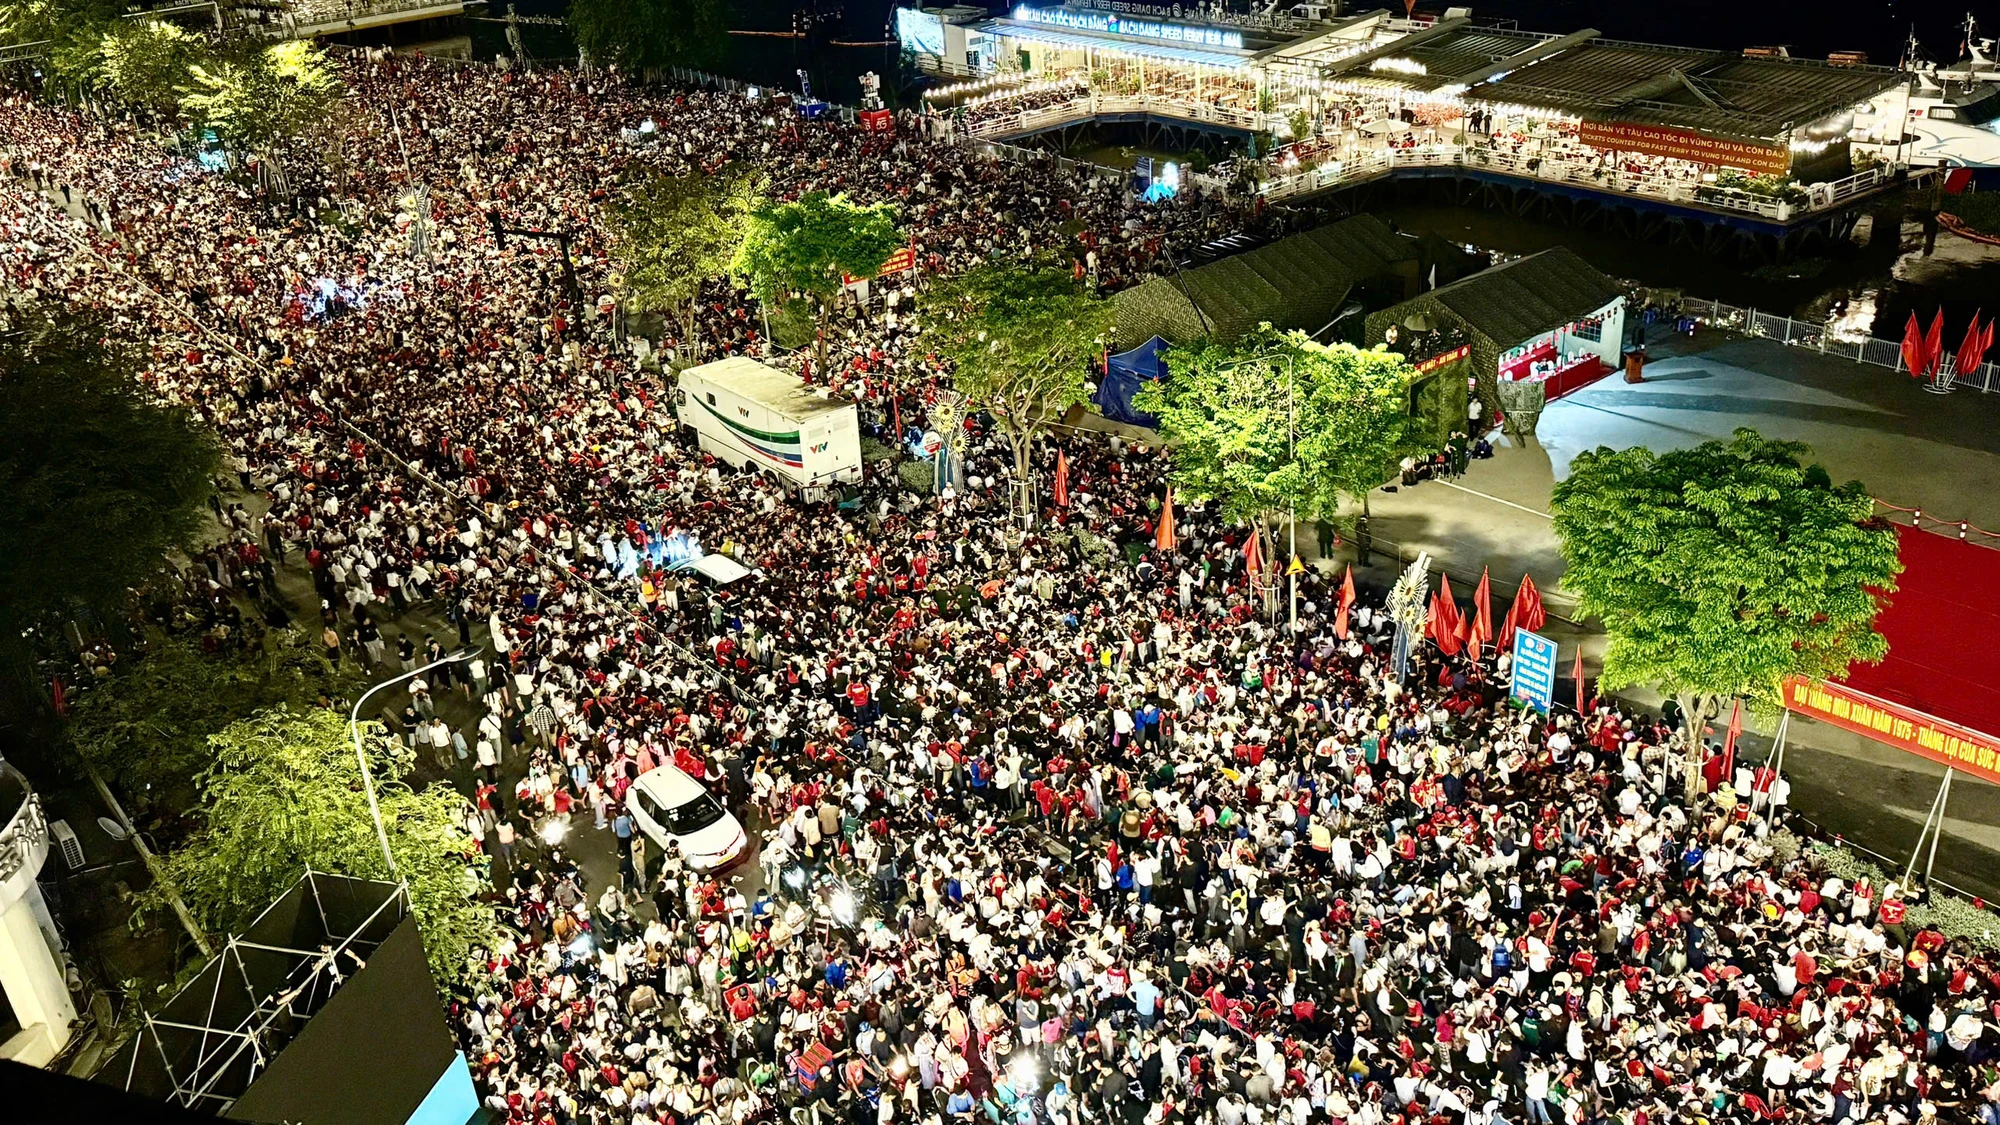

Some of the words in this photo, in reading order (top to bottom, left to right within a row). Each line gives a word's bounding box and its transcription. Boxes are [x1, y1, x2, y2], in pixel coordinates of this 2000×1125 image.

[1140, 22, 1160, 38] DANG
[1582, 133, 1605, 142] TICKETS
[1606, 137, 1636, 146] COUNTER
[1637, 141, 1650, 149] FOR
[1651, 143, 1667, 151] FAST
[1669, 146, 1689, 154] FERRY
[1691, 149, 1699, 157] TO
[1701, 151, 1720, 160] VUNG
[1722, 154, 1735, 162] TAU
[1752, 159, 1767, 167] CON
[1769, 162, 1785, 170] DAO
[1627, 128, 1642, 137] TÀU
[1644, 131, 1660, 140] CAO
[1662, 132, 1678, 142] TỐC
[1680, 136, 1688, 144] ĐI
[1690, 138, 1712, 148] VŨNG
[1714, 140, 1730, 150] TÀU
[1746, 145, 1764, 155] CÔN
[810, 441, 828, 454] VTV
[1832, 696, 1851, 720] MÙA
[1850, 703, 1873, 727] XUÂN
[1872, 710, 1892, 734] NĂM
[1892, 718, 1912, 740] 1975
[1944, 736, 1960, 760] LỢI
[1959, 737, 1976, 764] CỦA
[1976, 745, 1995, 770] SỨC
